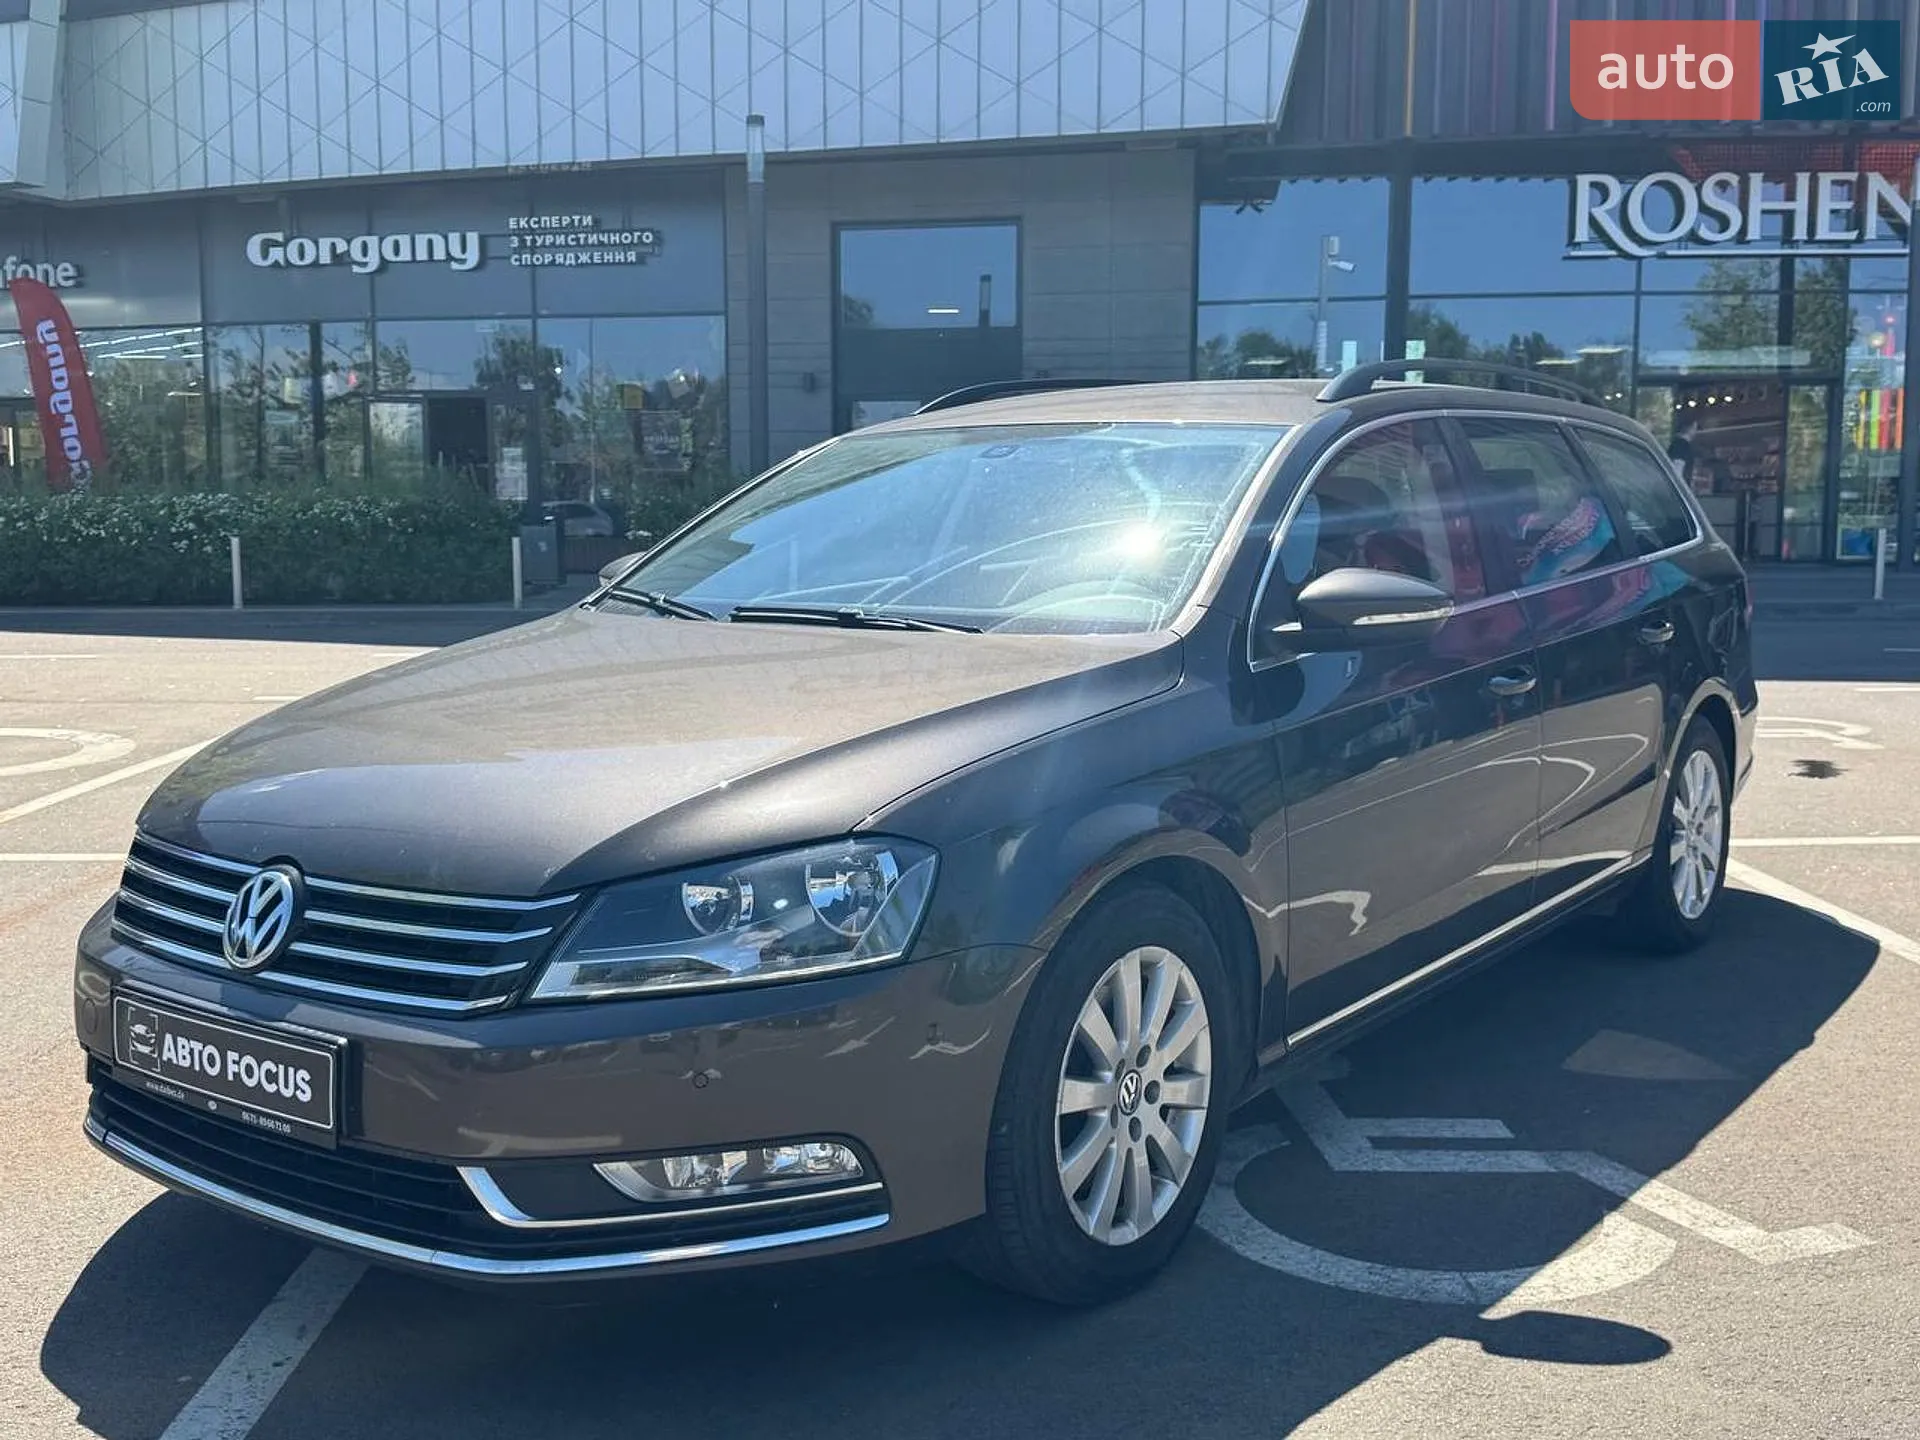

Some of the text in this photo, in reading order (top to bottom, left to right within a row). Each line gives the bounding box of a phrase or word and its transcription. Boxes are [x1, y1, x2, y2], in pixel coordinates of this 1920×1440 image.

[508, 215, 593, 229] ЕКСПЕРТИ
[1574, 172, 1912, 257] ROSHEN
[246, 231, 480, 274] Gorgany
[524, 231, 654, 247] ТУРИСТИЧНОГО
[0, 254, 78, 289] fone
[510, 251, 637, 266] СПОРЯДЖЕННЯ
[162, 1033, 312, 1102] АВТО FOCUS
